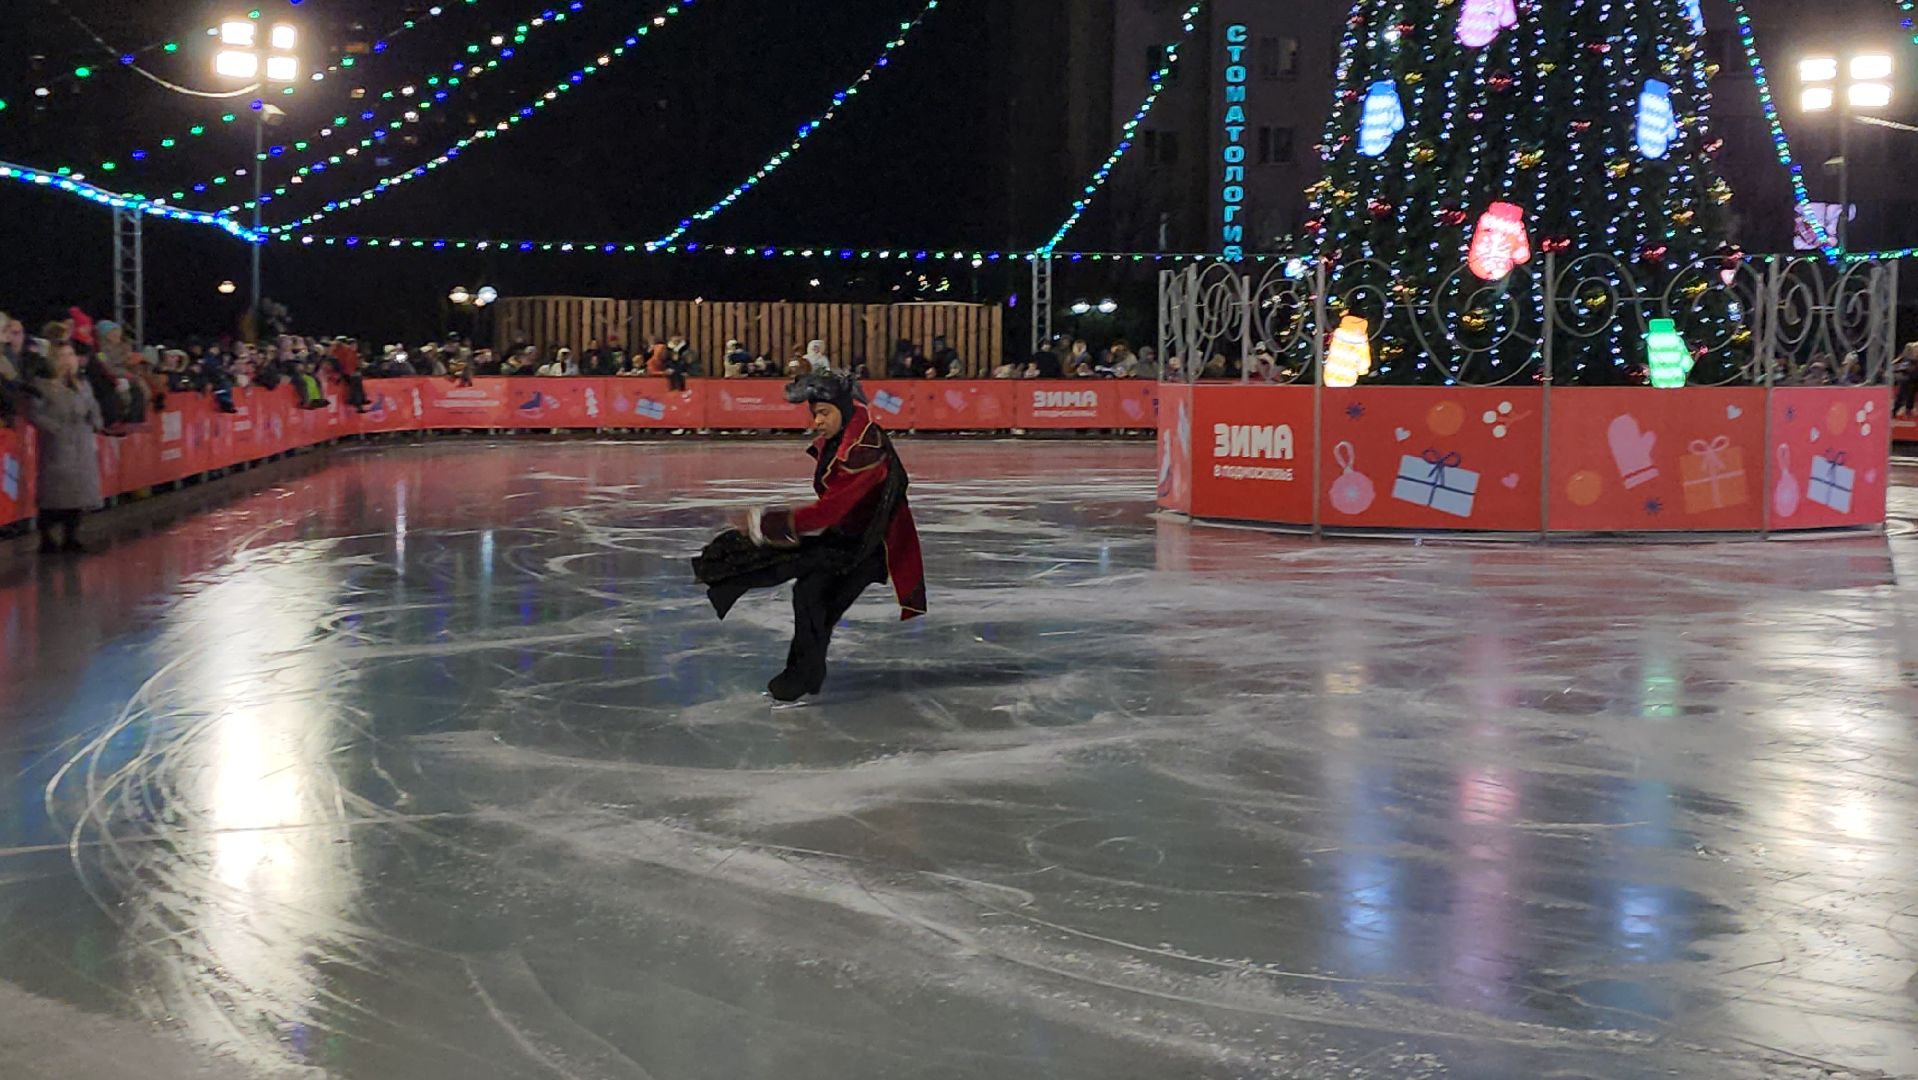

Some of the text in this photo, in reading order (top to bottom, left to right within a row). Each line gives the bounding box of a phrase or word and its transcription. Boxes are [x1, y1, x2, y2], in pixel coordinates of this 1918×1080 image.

[1223, 23, 1248, 262] СТОМАТОЛОГИЯ
[1033, 390, 1098, 408] ЗИМА
[1213, 423, 1294, 459] ЗИМА
